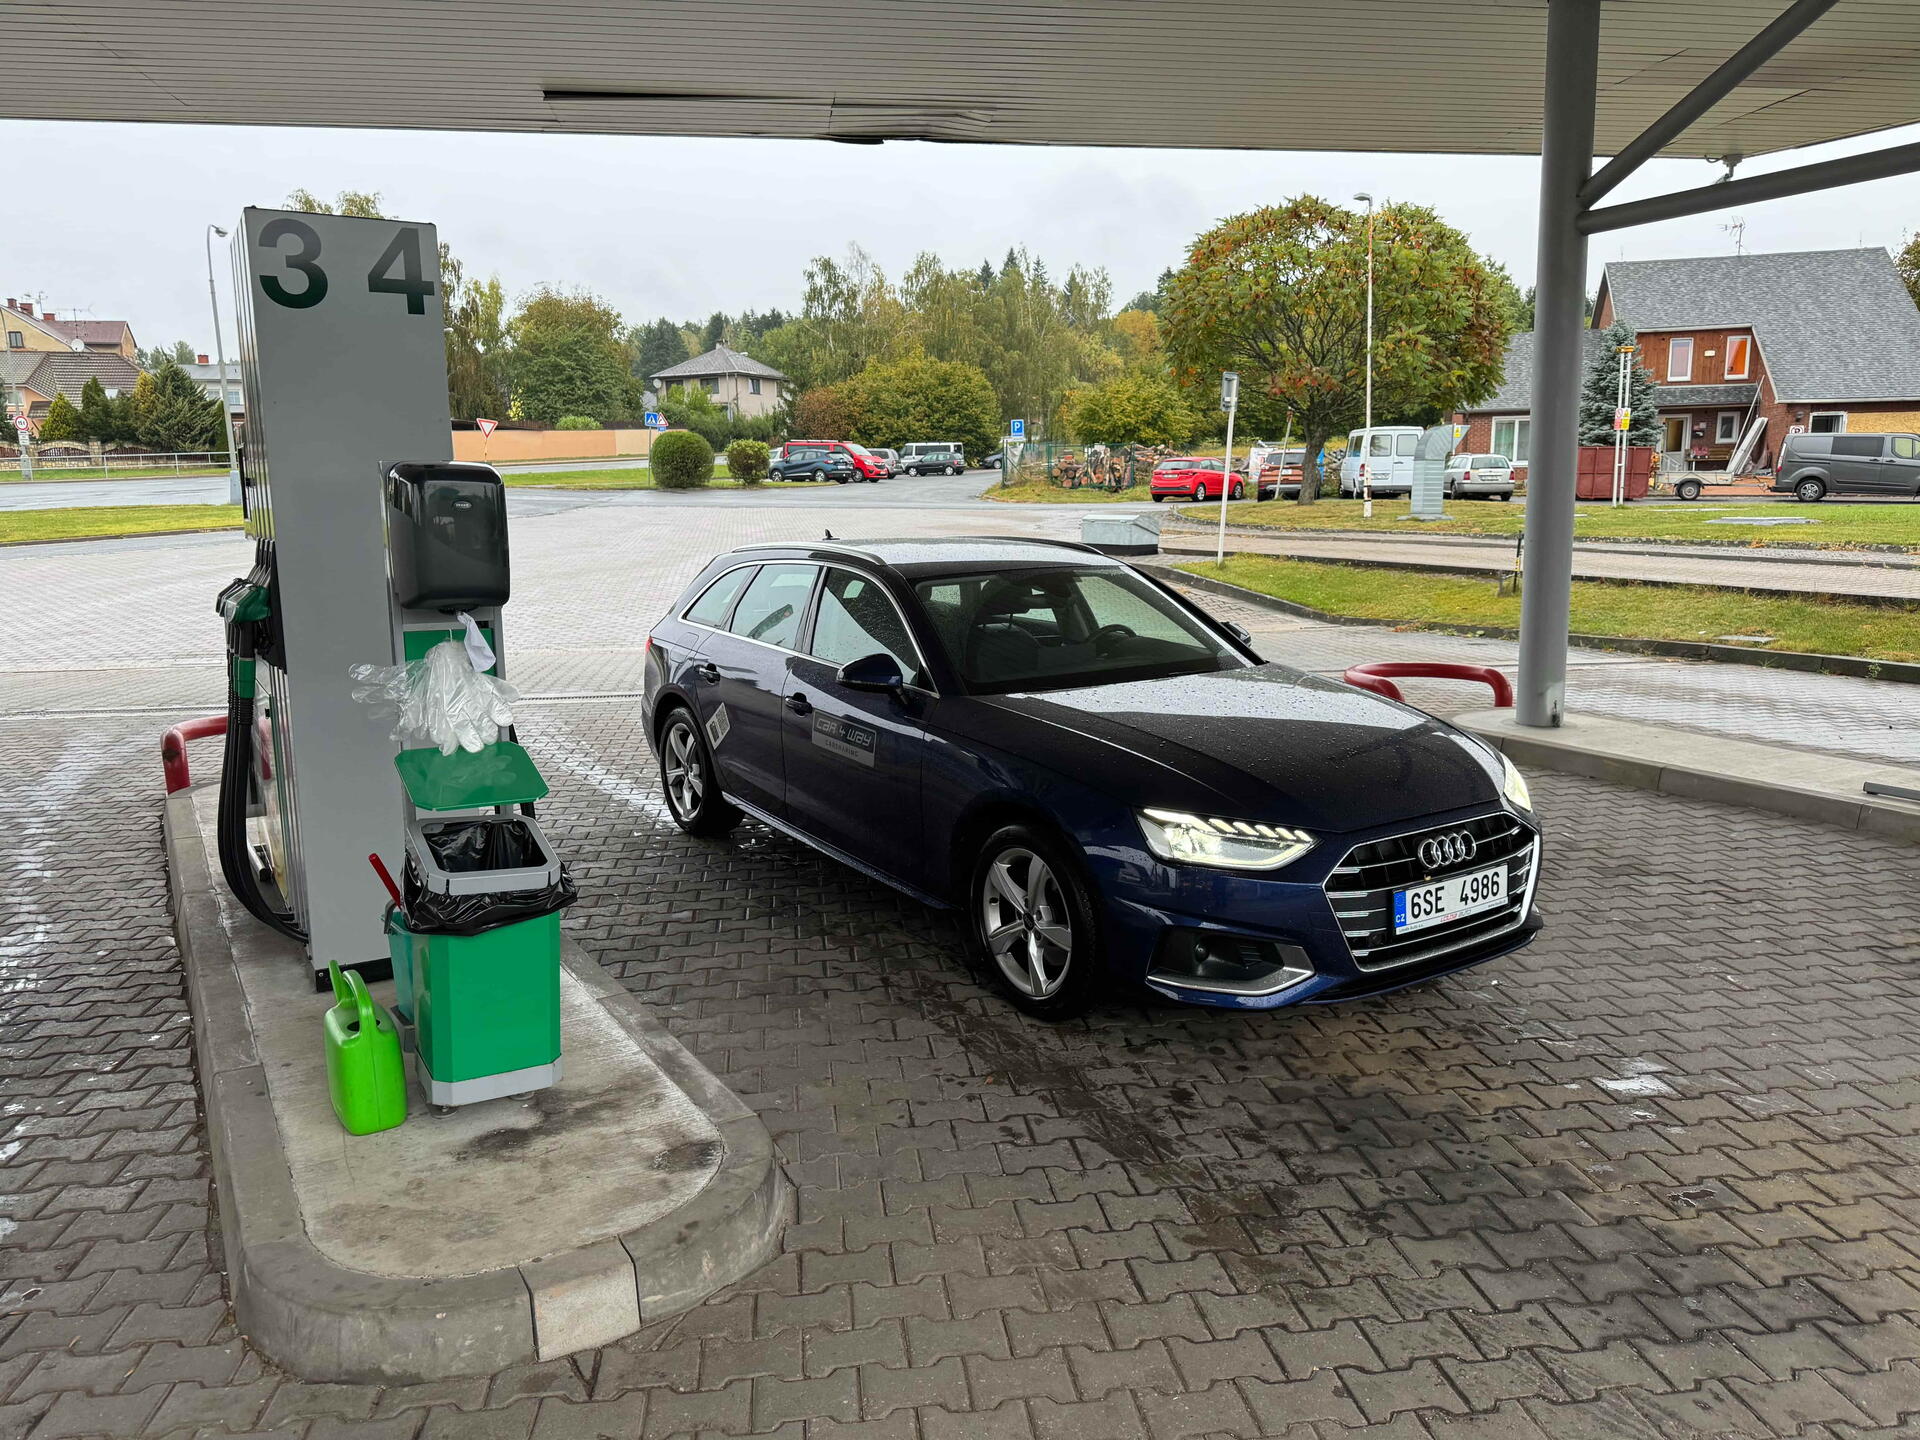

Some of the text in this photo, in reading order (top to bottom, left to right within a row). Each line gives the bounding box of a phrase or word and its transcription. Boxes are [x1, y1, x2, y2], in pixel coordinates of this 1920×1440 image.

[258, 218, 435, 315] 3 4
[1395, 913, 1406, 923] CZ
[1410, 871, 1500, 919] 6SE 4986
